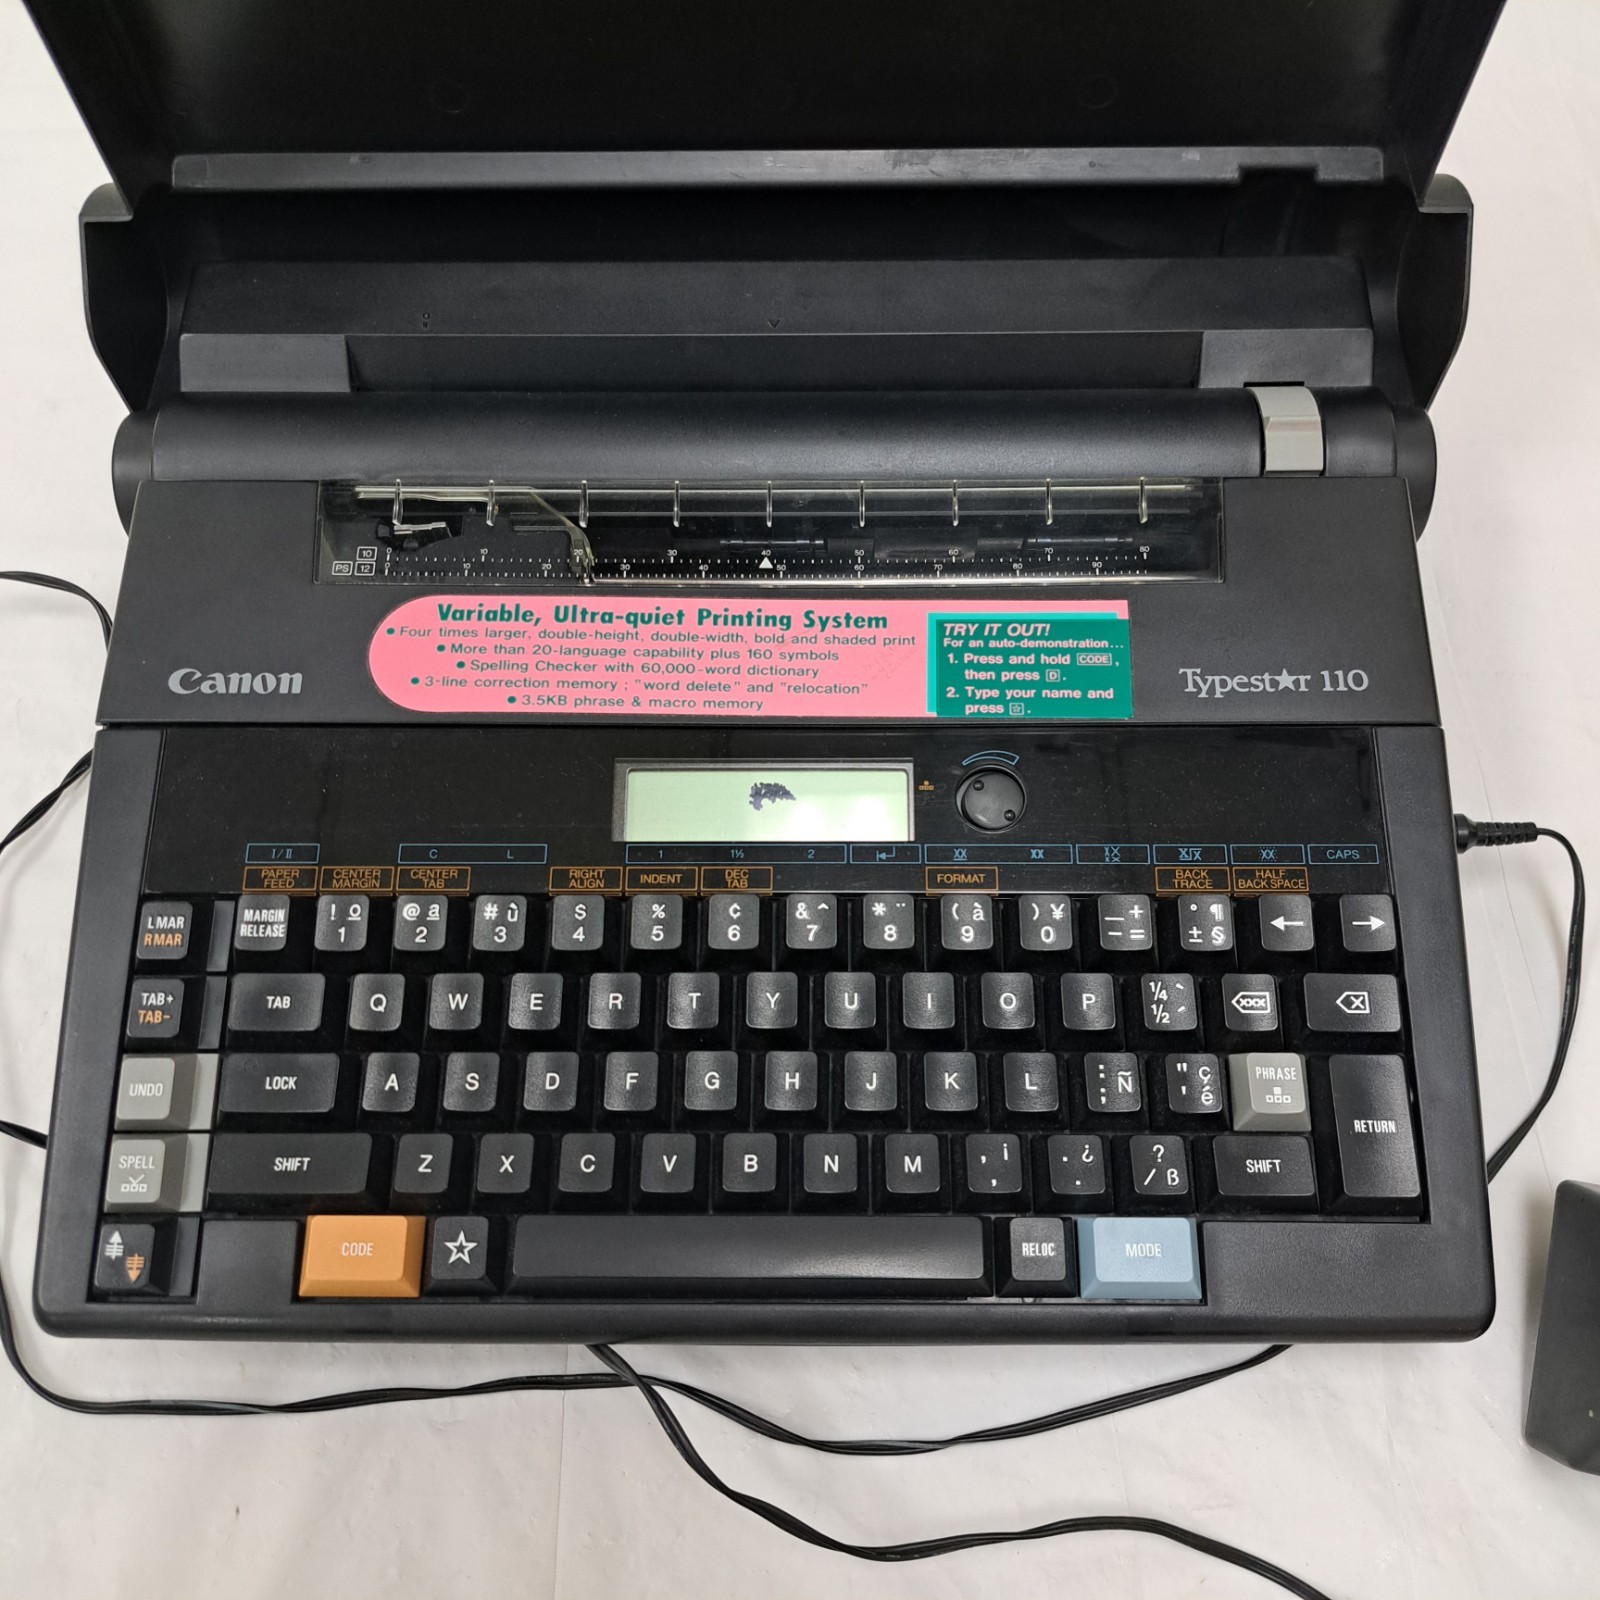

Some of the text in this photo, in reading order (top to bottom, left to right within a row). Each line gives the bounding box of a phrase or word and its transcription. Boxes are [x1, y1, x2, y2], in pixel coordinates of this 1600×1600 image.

[362, 549, 373, 559] 10
[667, 549, 677, 557] 30
[1044, 547, 1053, 555] 70
[1139, 545, 1149, 553] 80
[335, 564, 371, 573] PS 12
[1013, 562, 1022, 570] 80
[1092, 561, 1102, 569] 90
[437, 602, 888, 632] Variable, Ultra-quiet Printing System
[399, 625, 916, 649] Four times larger, double-height, double-width, bold and shaded print
[943, 623, 1051, 637] TRY IT OUT!
[943, 637, 1124, 649] For an auto-demonstration...
[449, 643, 839, 663] More than 20-language capability plus 160 symbols
[947, 652, 1110, 665] 1. Press and hold CODE
[470, 659, 819, 679] Spelling Checker with 60,000-word dictionary
[964, 668, 1040, 684] then press
[167, 667, 303, 695] Canon
[424, 675, 468, 688] 3-line
[473, 676, 551, 689] correction
[555, 679, 619, 692] memory
[746, 681, 774, 694] and
[1320, 669, 1369, 692] 110
[946, 686, 1114, 702] 2. Type your name and
[521, 694, 764, 712] 3.5KB phrase & macro memory
[965, 703, 1005, 716] press
[428, 849, 438, 860] C
[658, 849, 815, 859] 1 2
[1326, 850, 1360, 860] CAPS
[260, 869, 300, 879] PAPER
[333, 869, 382, 879] CENTER
[410, 869, 458, 879] CENTER
[569, 869, 605, 879] RIGHT
[639, 874, 683, 884] INDENT
[724, 869, 749, 879] DEC
[936, 874, 986, 884] FORMAT
[1175, 869, 1209, 879] BACK
[1255, 869, 1286, 879] HALF
[264, 878, 295, 889] FEED
[332, 878, 381, 889] MARGIN
[422, 878, 445, 889] TAB
[568, 879, 605, 889] ALIGN
[725, 879, 749, 889] TAB
[1173, 879, 1213, 889] TRACE
[1238, 879, 1305, 889] BACK SPACE
[243, 909, 285, 922] MARGIN
[240, 924, 285, 938] RELEASE
[337, 926, 346, 943] 1
[415, 927, 428, 943] 2
[493, 926, 507, 943] 3
[572, 926, 586, 942] 4
[650, 925, 664, 942] 5
[727, 925, 741, 942] 6
[805, 924, 819, 942] 7
[883, 925, 898, 942] 8
[961, 925, 974, 943] 9
[1040, 926, 1055, 943] 0
[266, 995, 291, 1009] TAB
[369, 993, 388, 1013] Q
[448, 993, 469, 1010] W
[530, 993, 544, 1010] E
[609, 993, 623, 1010] R
[688, 992, 702, 1010] T
[765, 992, 781, 1009] Y
[844, 992, 858, 1009] U
[927, 993, 932, 1009] I
[1000, 992, 1017, 1010] O
[1082, 993, 1096, 1010] P
[704, 1071, 721, 1090] G
[785, 1072, 800, 1090] H
[944, 1072, 961, 1090] K
[1255, 1066, 1297, 1080] PHRASE
[265, 1076, 297, 1090] LOCK
[384, 1073, 399, 1091] A
[464, 1072, 480, 1091] S
[545, 1072, 560, 1091] D
[625, 1072, 639, 1091] F
[865, 1072, 878, 1091] J
[1024, 1072, 1038, 1091] L
[129, 1083, 164, 1097] UNDO
[1353, 1119, 1397, 1134] RETURN
[118, 1155, 156, 1169] SPELL
[273, 1157, 310, 1172] SHIFT
[417, 1154, 434, 1173] Z
[499, 1154, 516, 1173] X
[580, 1154, 596, 1173] C
[662, 1154, 678, 1172] V
[743, 1154, 758, 1172] B
[824, 1154, 839, 1173] N
[904, 1155, 922, 1173] M
[1245, 1159, 1281, 1174] SHIFT
[341, 1242, 374, 1257] CODE
[1021, 1242, 1055, 1257] RELOC
[1125, 1243, 1162, 1258] MODE
